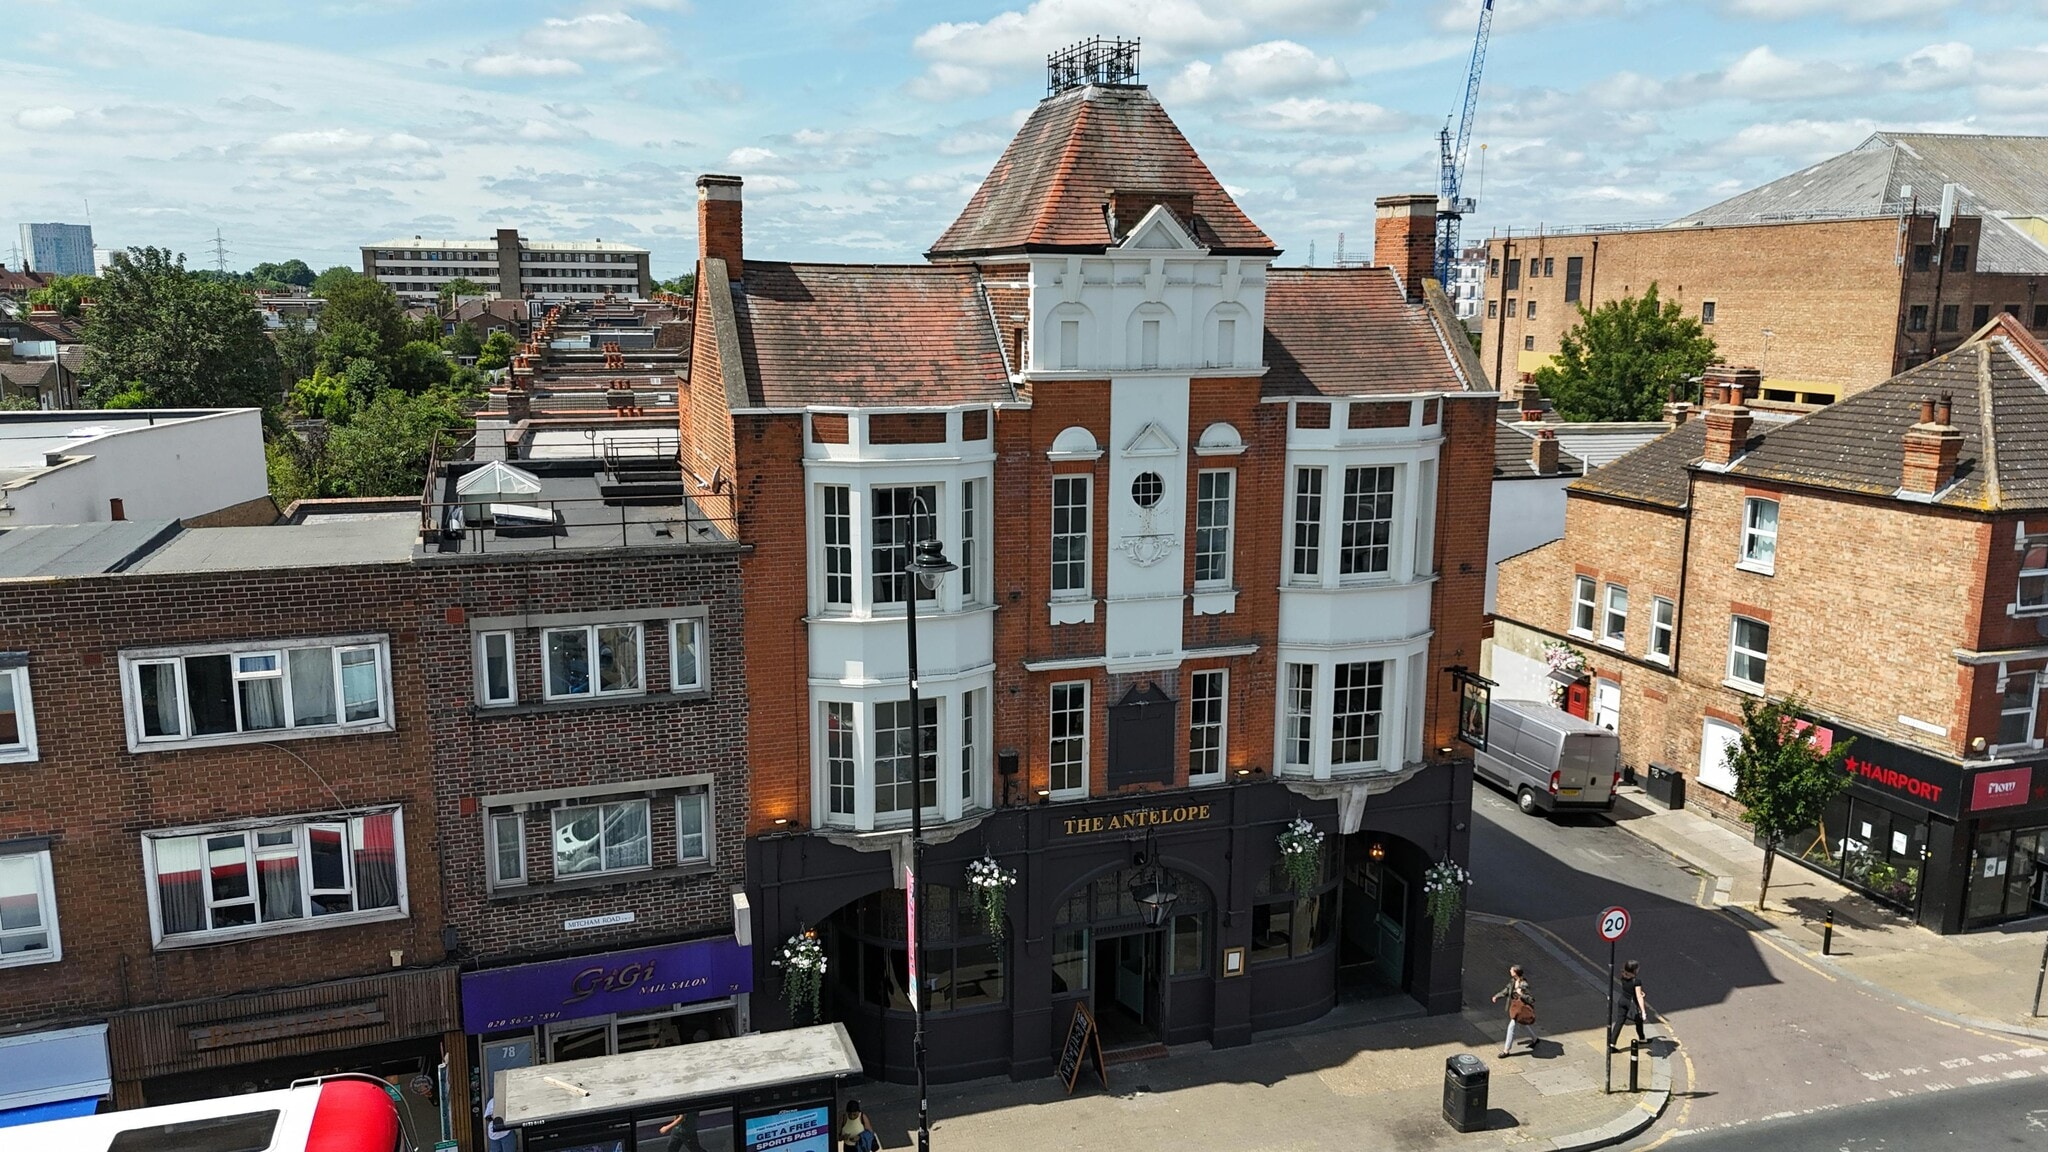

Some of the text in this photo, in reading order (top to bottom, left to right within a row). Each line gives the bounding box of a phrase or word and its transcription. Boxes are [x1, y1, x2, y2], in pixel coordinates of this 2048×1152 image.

[1860, 761, 1943, 802] HAIRPORT
[1063, 804, 1211, 835] THE ANTELOPE
[567, 918, 600, 929] MITCHAM
[602, 915, 621, 924] ROAD
[1605, 916, 1625, 932] 20
[638, 976, 709, 995] NAIL SALON
[487, 1019, 506, 1029] 020
[502, 1046, 516, 1058] 78
[756, 1119, 818, 1141] GET A FREE
[756, 1129, 818, 1150] SPORTS PASS
